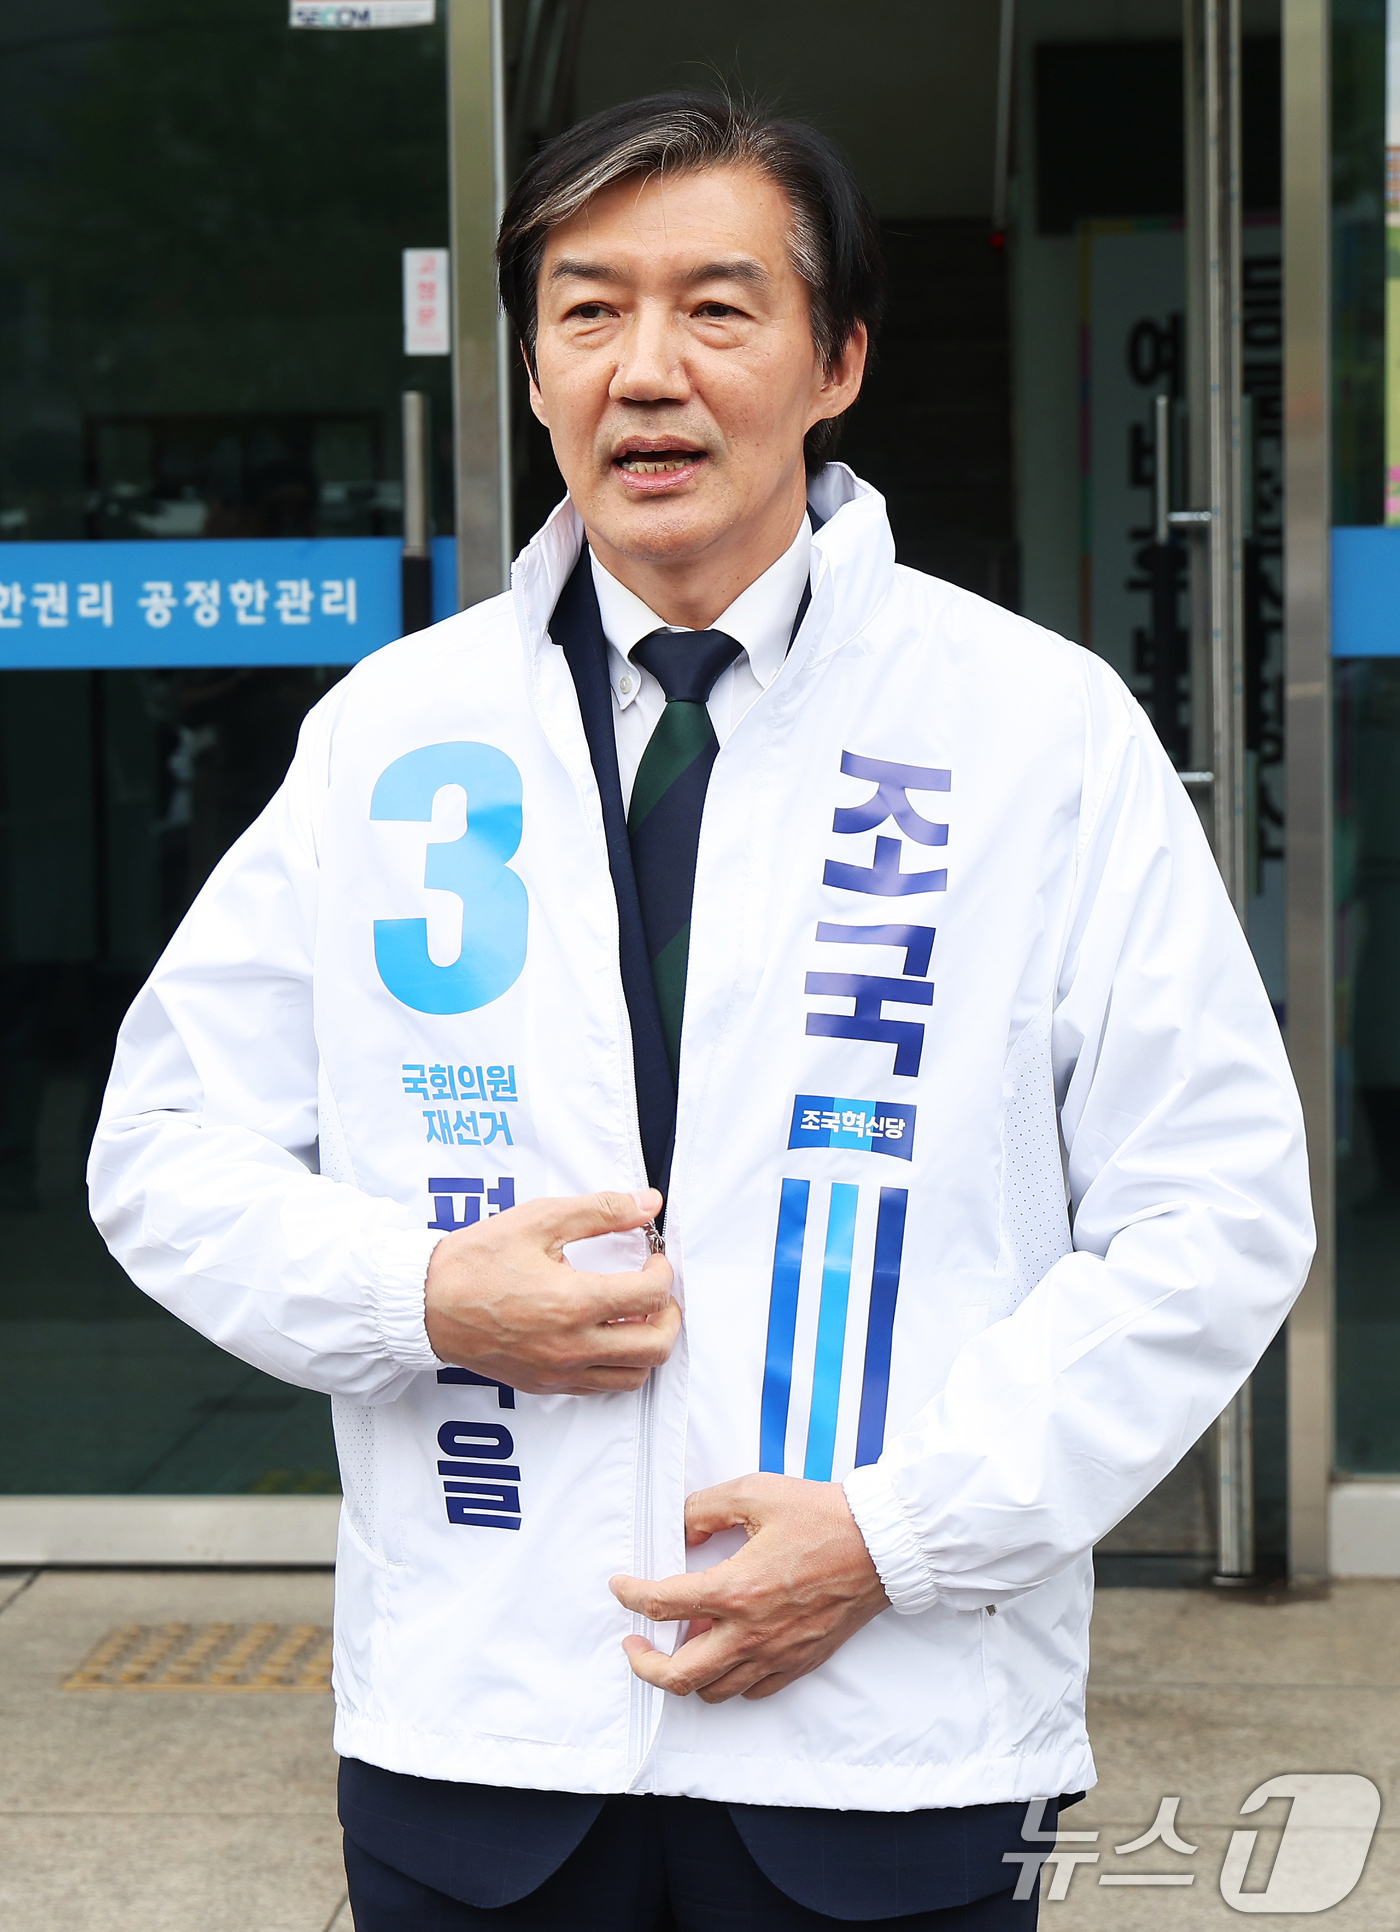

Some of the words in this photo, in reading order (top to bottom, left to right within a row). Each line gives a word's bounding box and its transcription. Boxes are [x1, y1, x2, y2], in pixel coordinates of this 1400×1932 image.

[138, 578, 357, 628] 공정한관리
[369, 741, 529, 1015] 3
[804, 749, 952, 1078] 조국
[401, 1064, 518, 1102] 국회의원
[422, 1110, 514, 1147] 재선거
[799, 1108, 906, 1140] 조국혁신당
